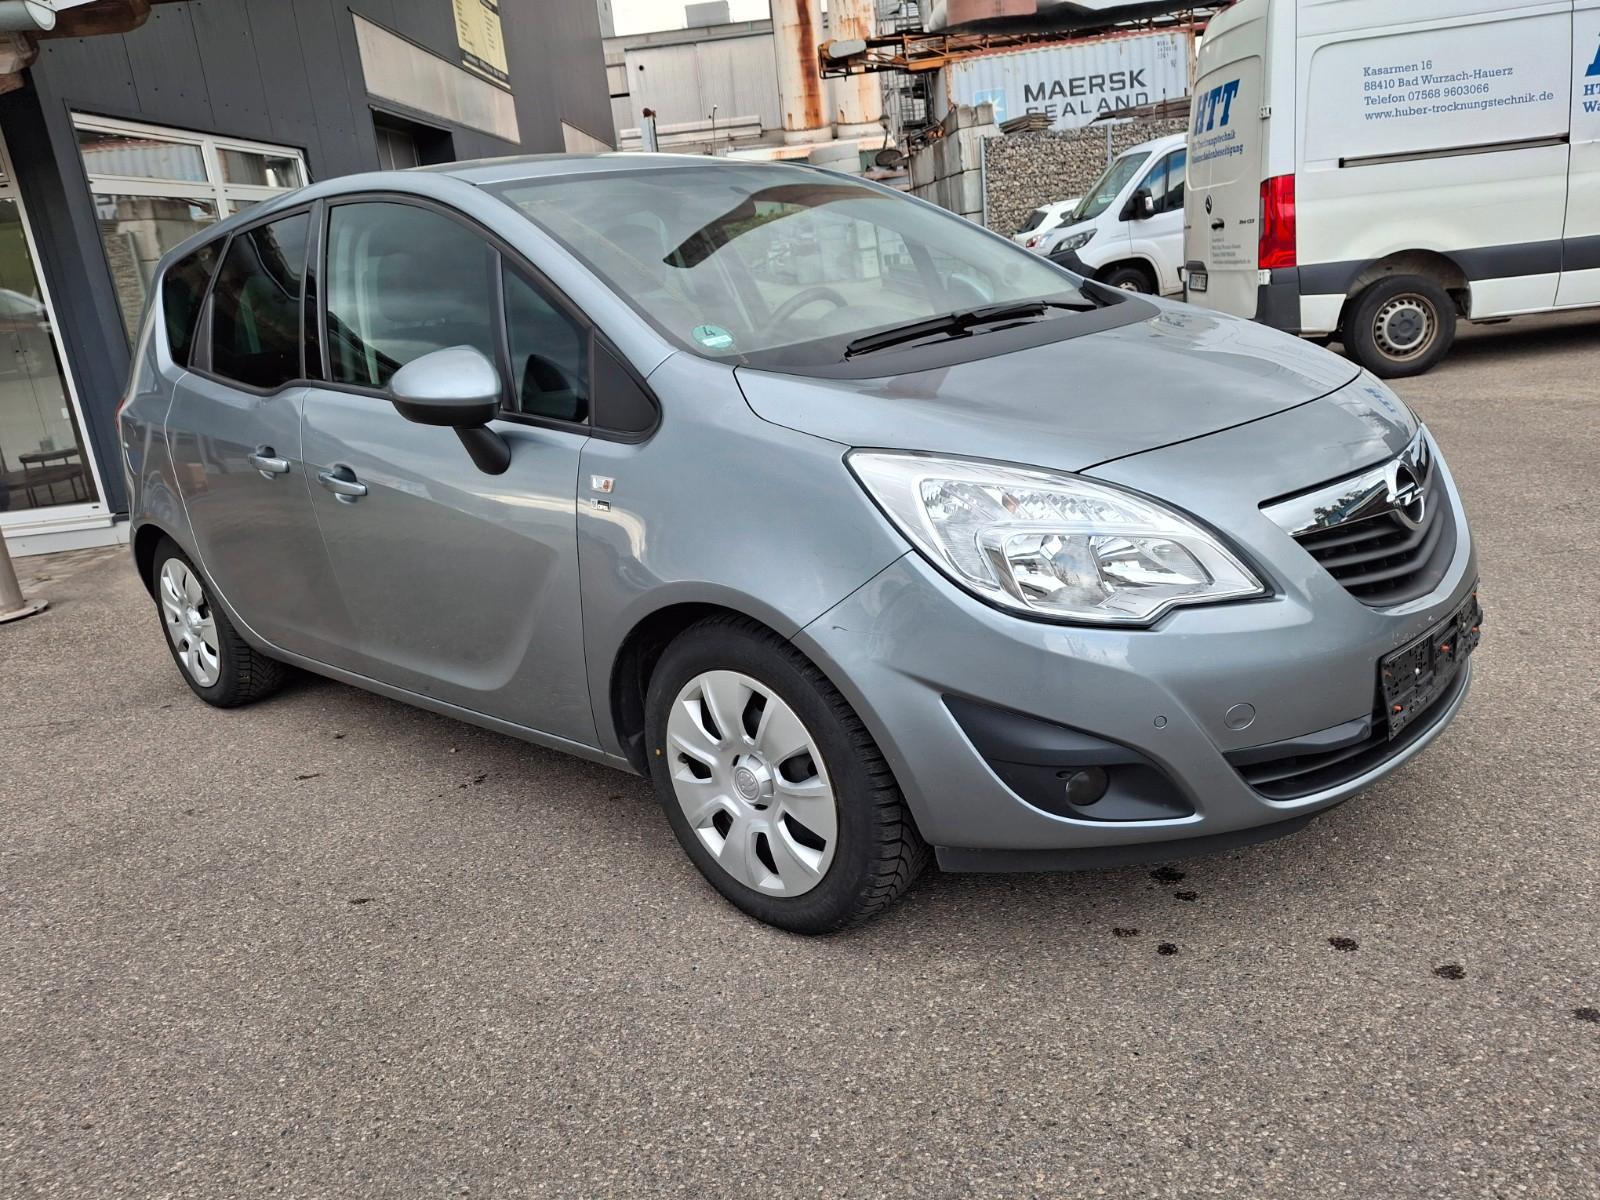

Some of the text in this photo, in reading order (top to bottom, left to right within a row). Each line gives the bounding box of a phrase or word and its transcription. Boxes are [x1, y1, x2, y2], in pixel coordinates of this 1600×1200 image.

[1421, 59, 1433, 71] 16
[1024, 68, 1147, 103] MAERSK
[1364, 67, 1514, 92] 88410 Bad Wurzach-Hauerz
[1194, 78, 1241, 136] HTT
[1364, 83, 1489, 106] Telefon 07568 9603066
[1365, 90, 1554, 121] www.huber-trocknungstechnik.de
